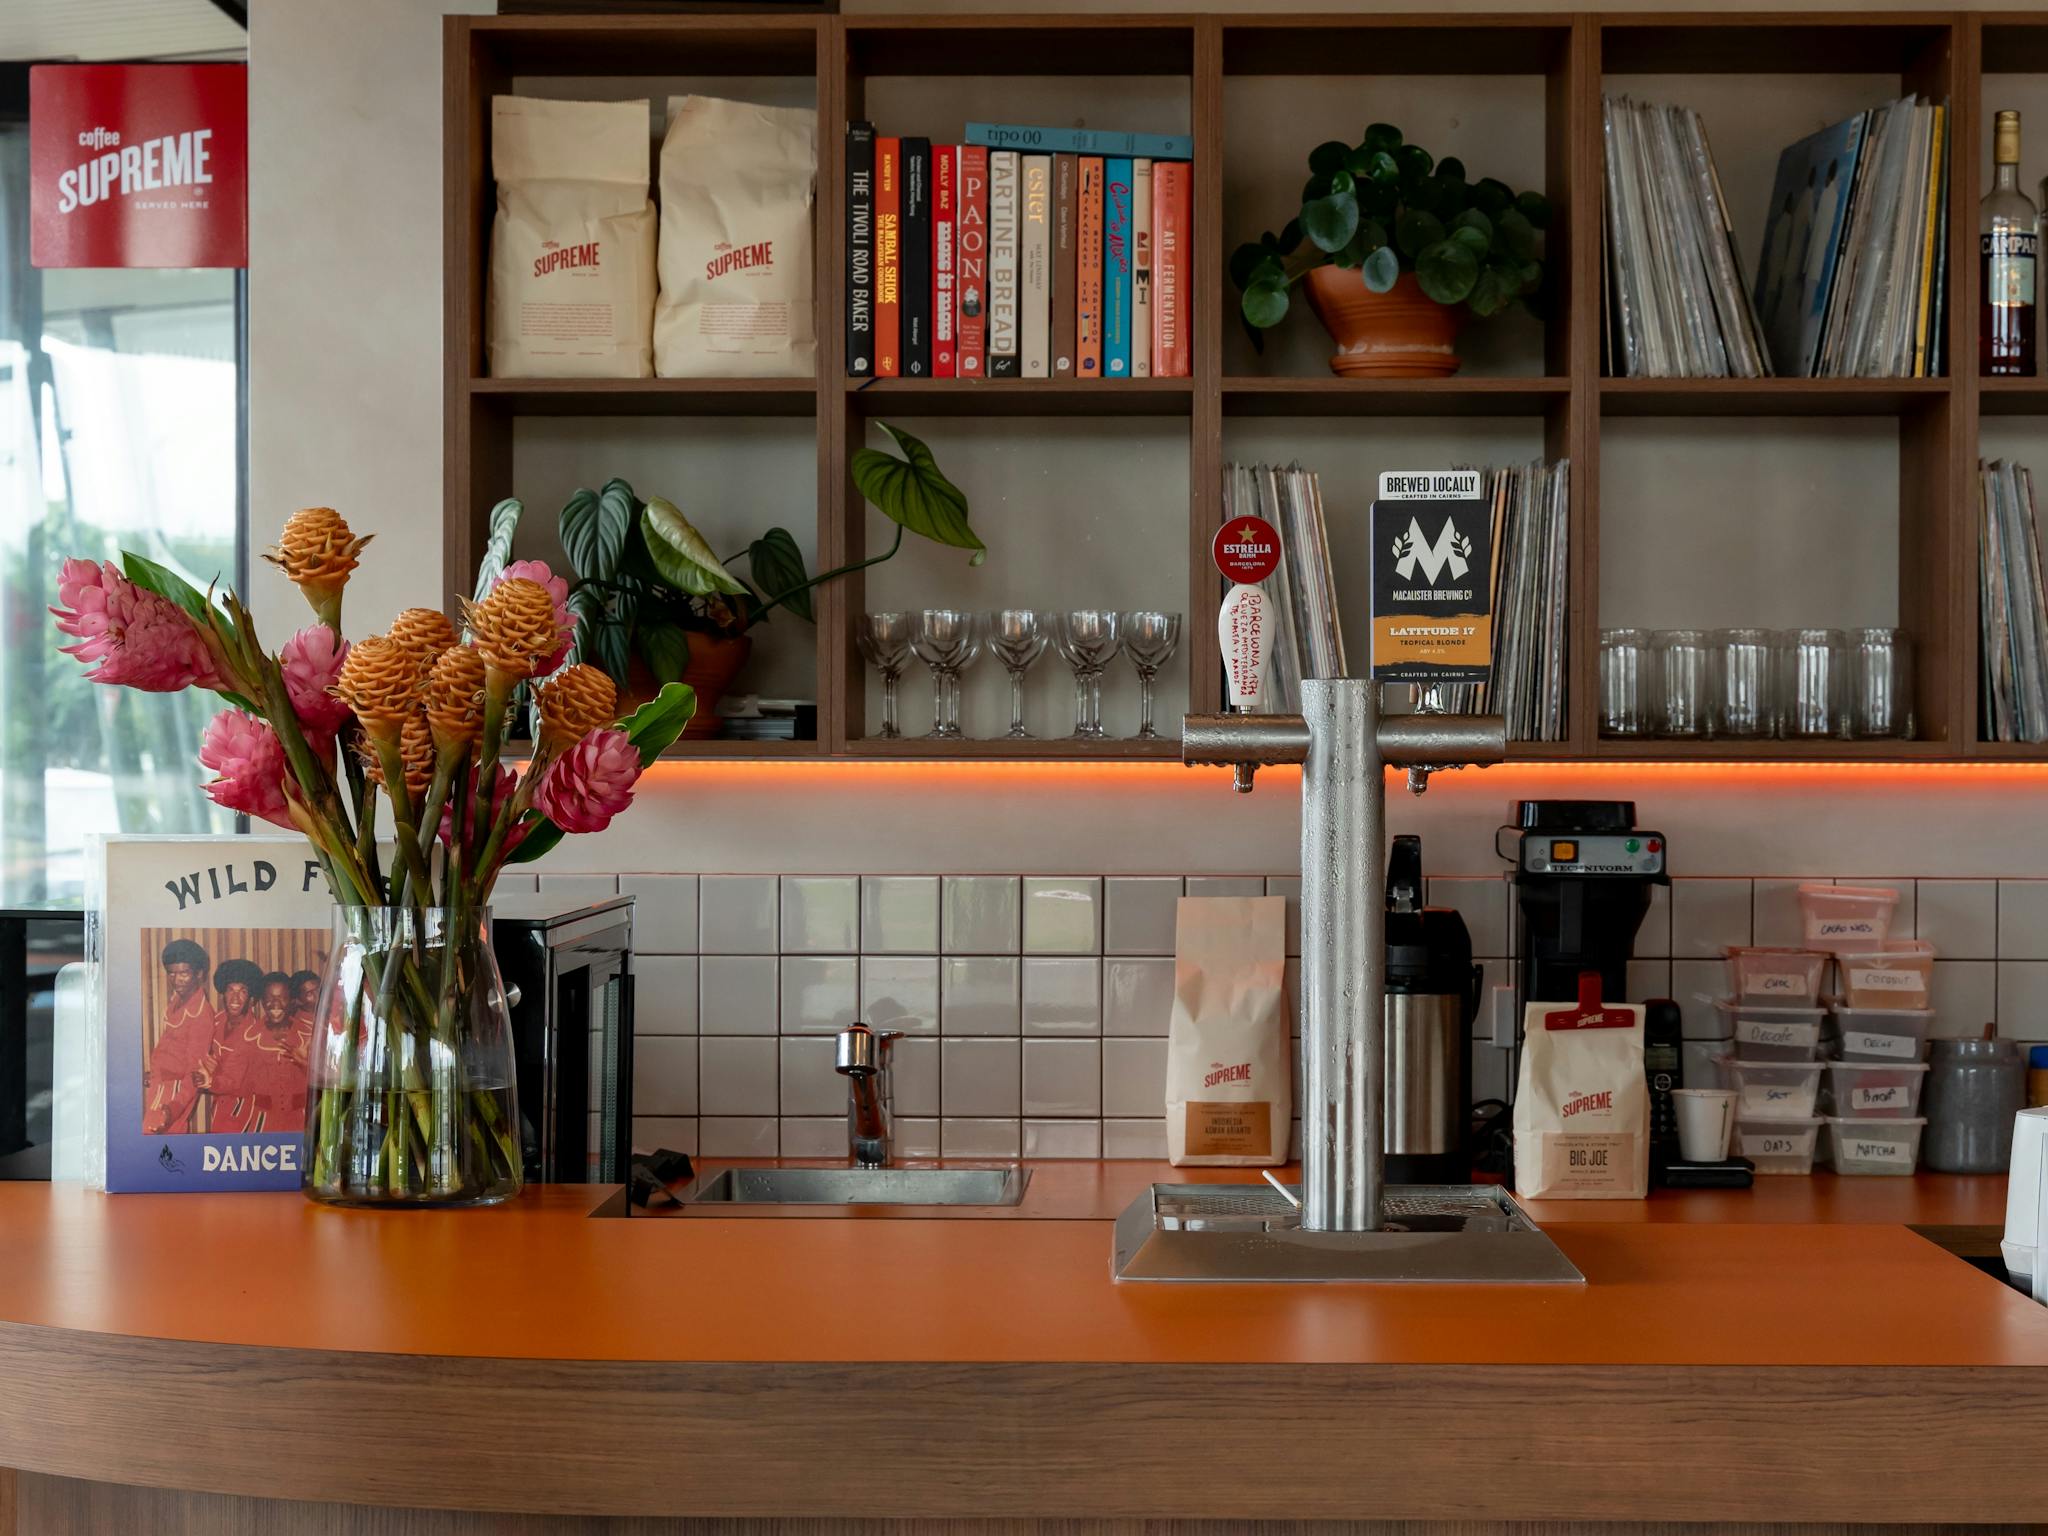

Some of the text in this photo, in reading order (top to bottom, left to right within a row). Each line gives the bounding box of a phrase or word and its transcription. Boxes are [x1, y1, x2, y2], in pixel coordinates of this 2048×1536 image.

[78, 126, 121, 151] coffee
[987, 125, 1019, 146] tipo
[58, 128, 213, 215] SUPREME
[939, 154, 949, 209] MOLLY BAZ
[135, 200, 209, 209] SERVED HERE
[1028, 167, 1046, 224] ester
[962, 177, 983, 279] PAON
[1163, 231, 1175, 252] ART
[852, 170, 869, 332] THE TIVOLI ROAD BAKER
[885, 213, 897, 304] SAMBAL SHIOK
[994, 154, 1013, 352] TARTINE BREAD
[1981, 236, 2038, 254] CAMPAR
[533, 242, 600, 278] SUPREME
[706, 241, 774, 281] SUPREME
[1136, 231, 1150, 305] RUMI
[1163, 264, 1175, 348] FERMENTATION
[1386, 476, 1475, 493] BREWED LOCALLY
[1223, 543, 1272, 554] ESTRELLA
[1392, 590, 1432, 601] MACALISTER
[1433, 590, 1464, 601] BREWING
[1389, 626, 1475, 636] LATITUDE 17
[165, 860, 277, 910] WILD
[1204, 1063, 1252, 1088] SUPREME
[1562, 1090, 1613, 1118] SUPREME
[202, 1144, 298, 1172] DANCE
[1569, 1150, 1609, 1166] BIG JOE
[1763, 1140, 1793, 1153] OATS
[1856, 1143, 1897, 1157] MATCHA
